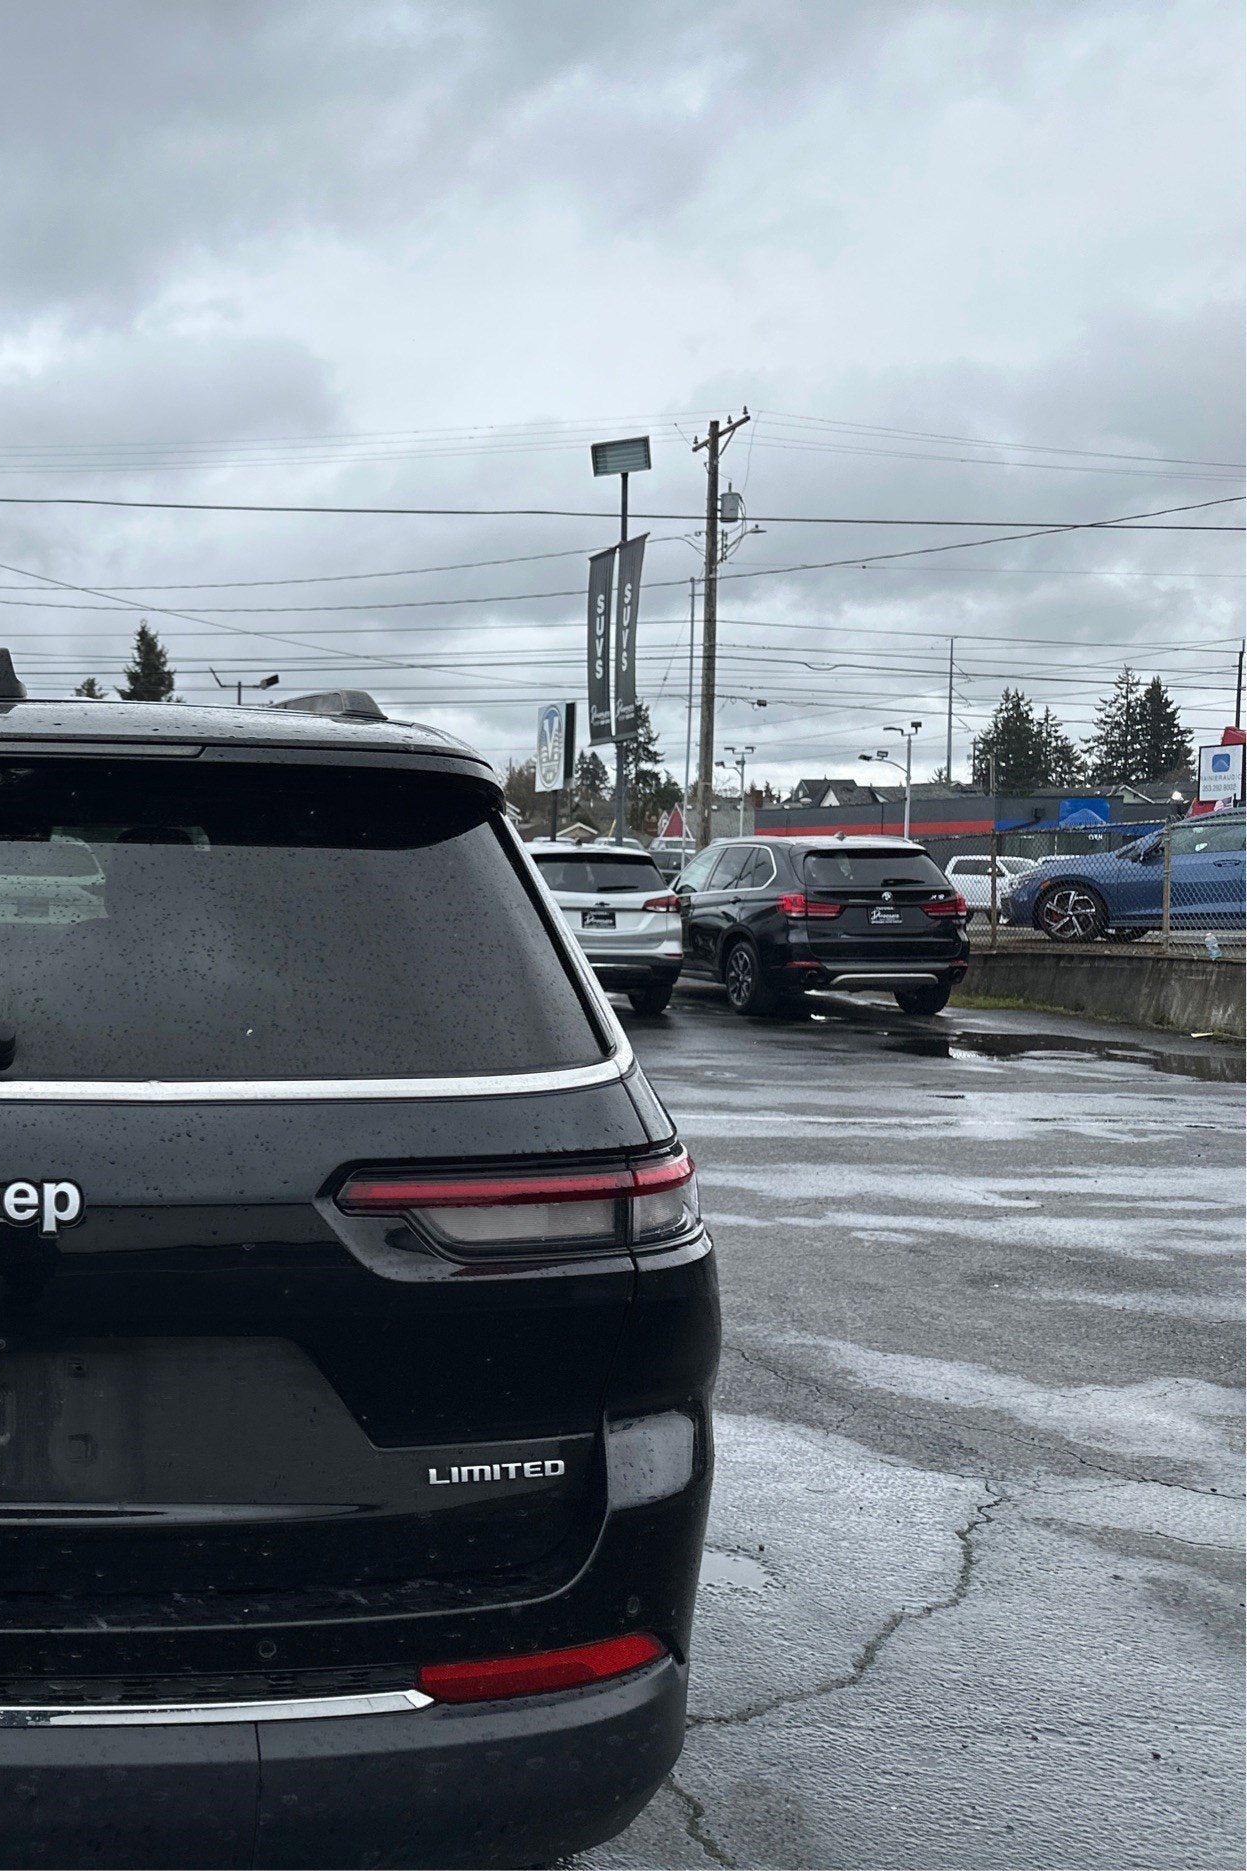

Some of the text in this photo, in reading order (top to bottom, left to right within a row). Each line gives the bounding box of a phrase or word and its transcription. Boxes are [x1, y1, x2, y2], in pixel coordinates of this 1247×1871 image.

[595, 594, 605, 680] SUVS
[620, 583, 632, 672] SUVS
[428, 1459, 565, 1485] LIMITED
